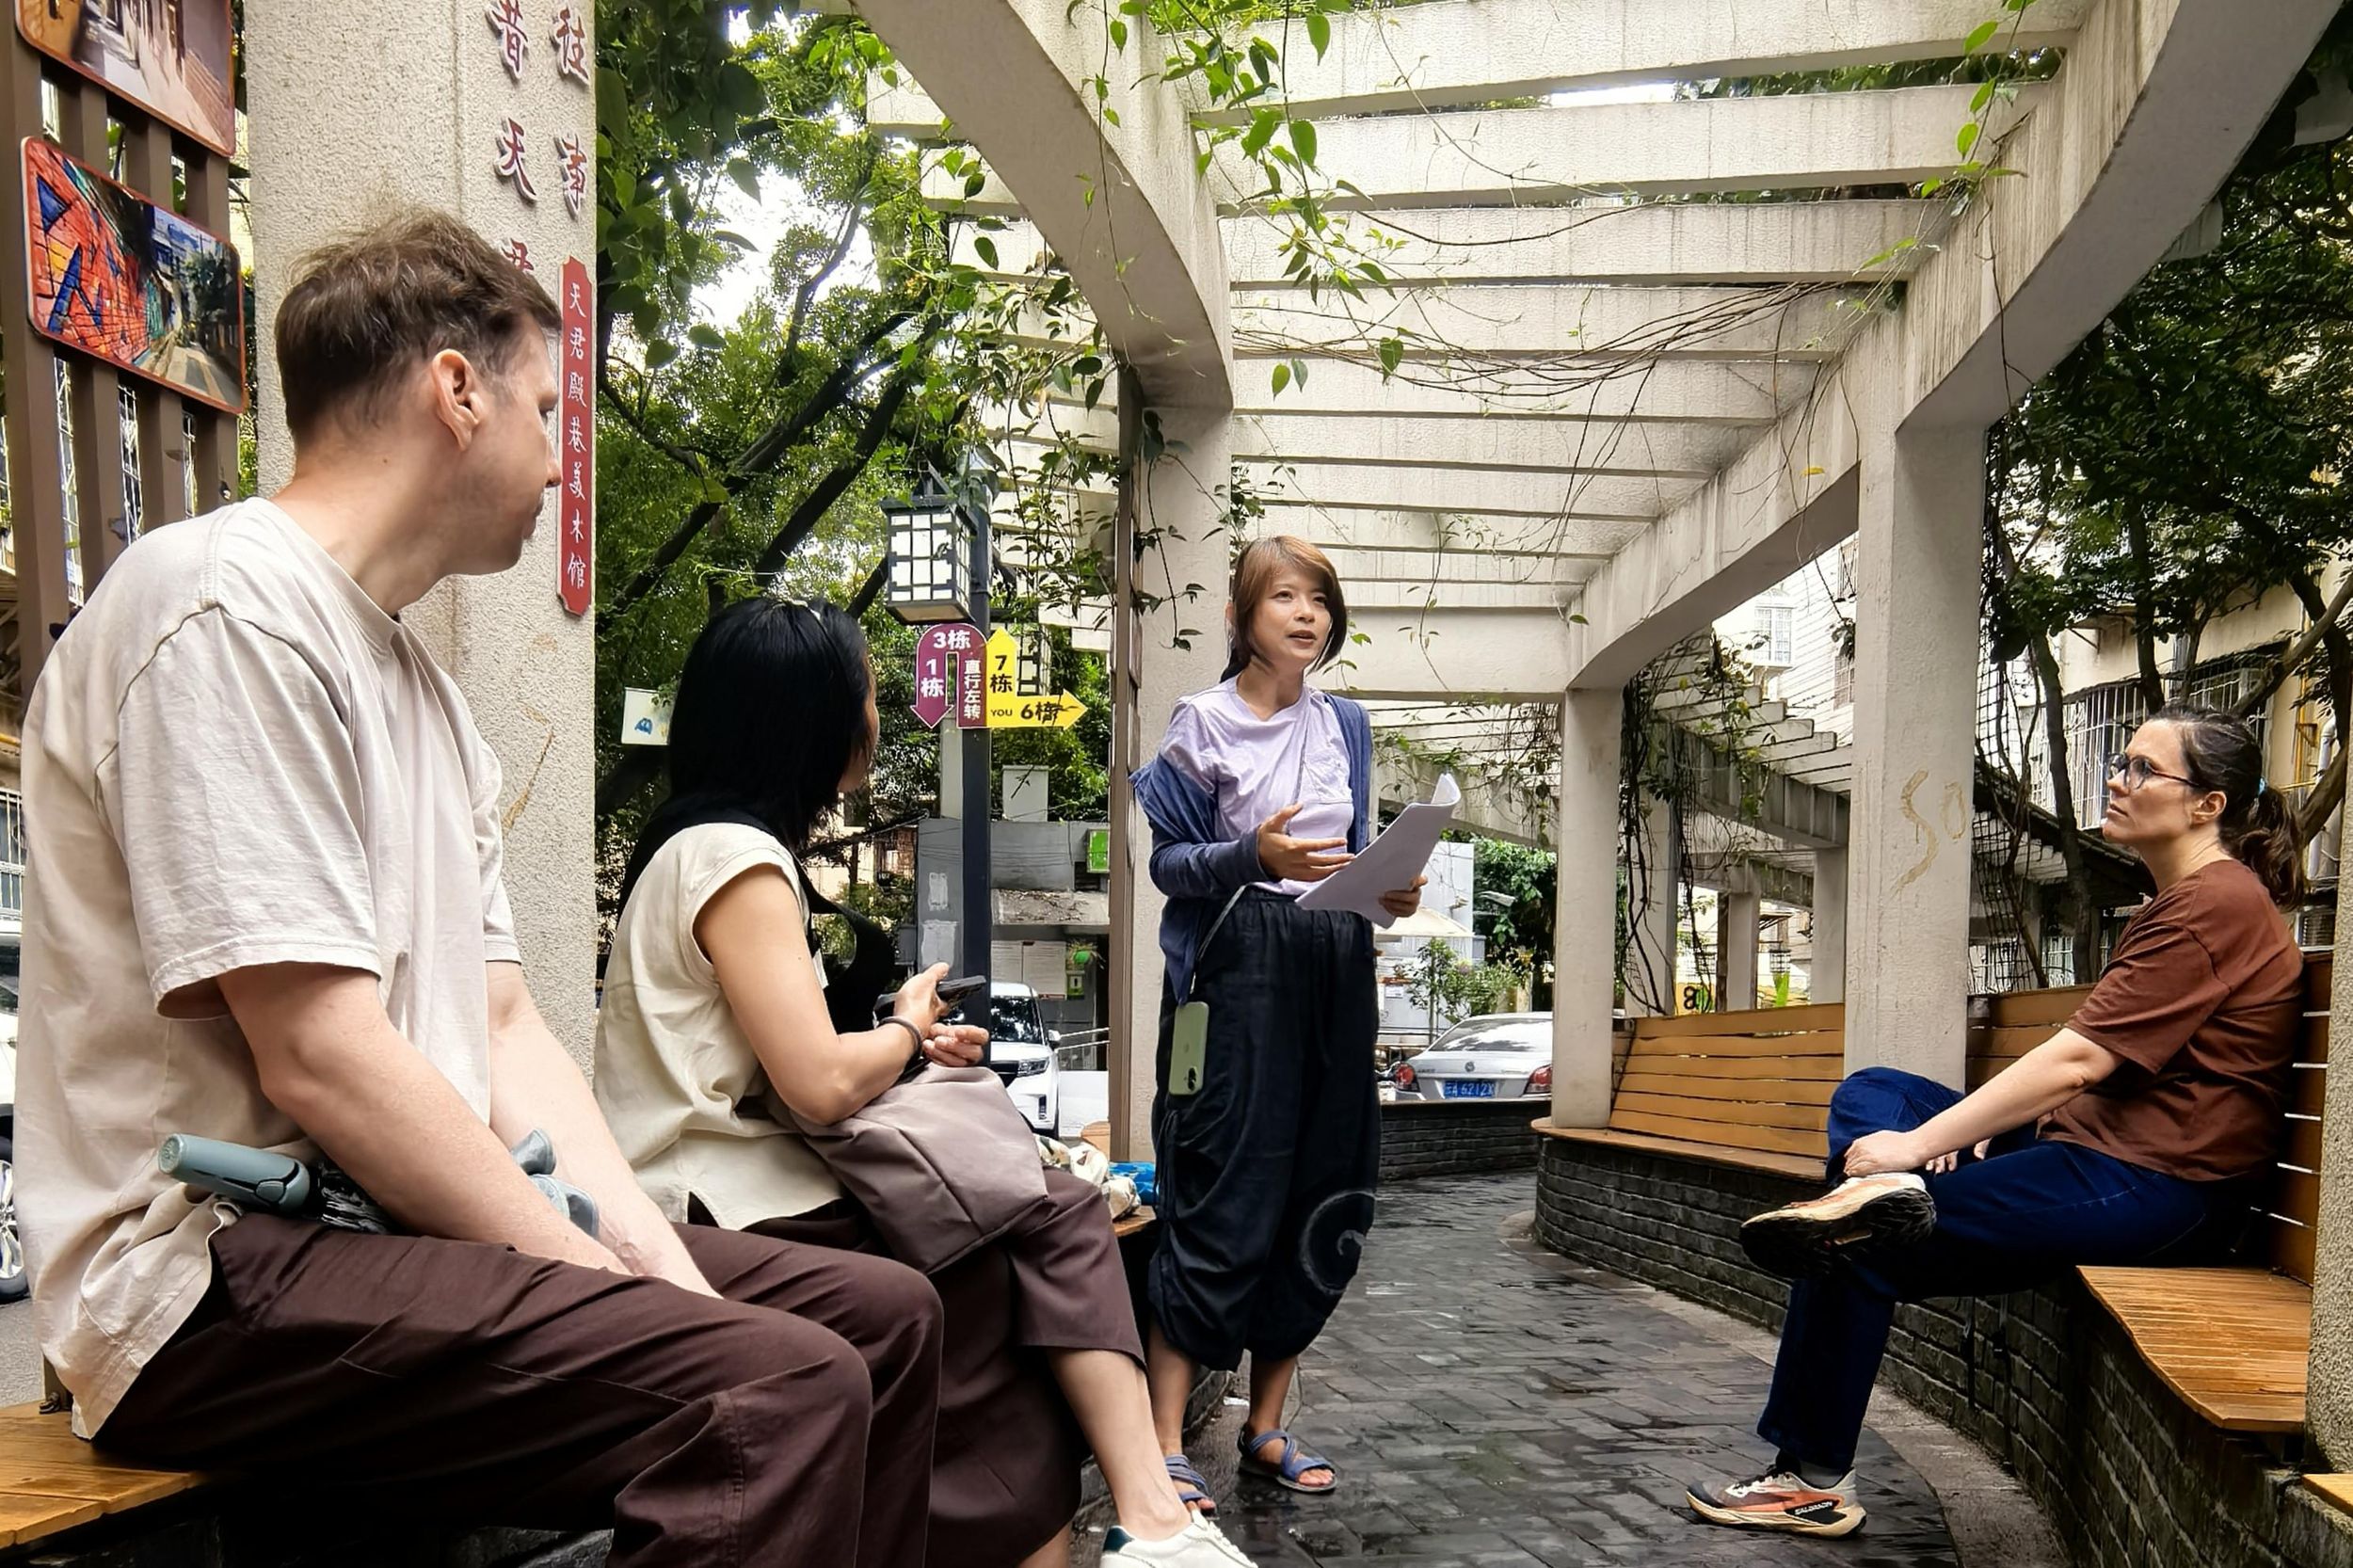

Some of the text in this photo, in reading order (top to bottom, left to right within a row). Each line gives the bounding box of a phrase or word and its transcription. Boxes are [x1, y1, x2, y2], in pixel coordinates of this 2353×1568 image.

[933, 629, 971, 649] 3栋
[920, 659, 944, 697] 1栋
[963, 660, 982, 720] 直行左转
[989, 655, 1013, 694] 7栋
